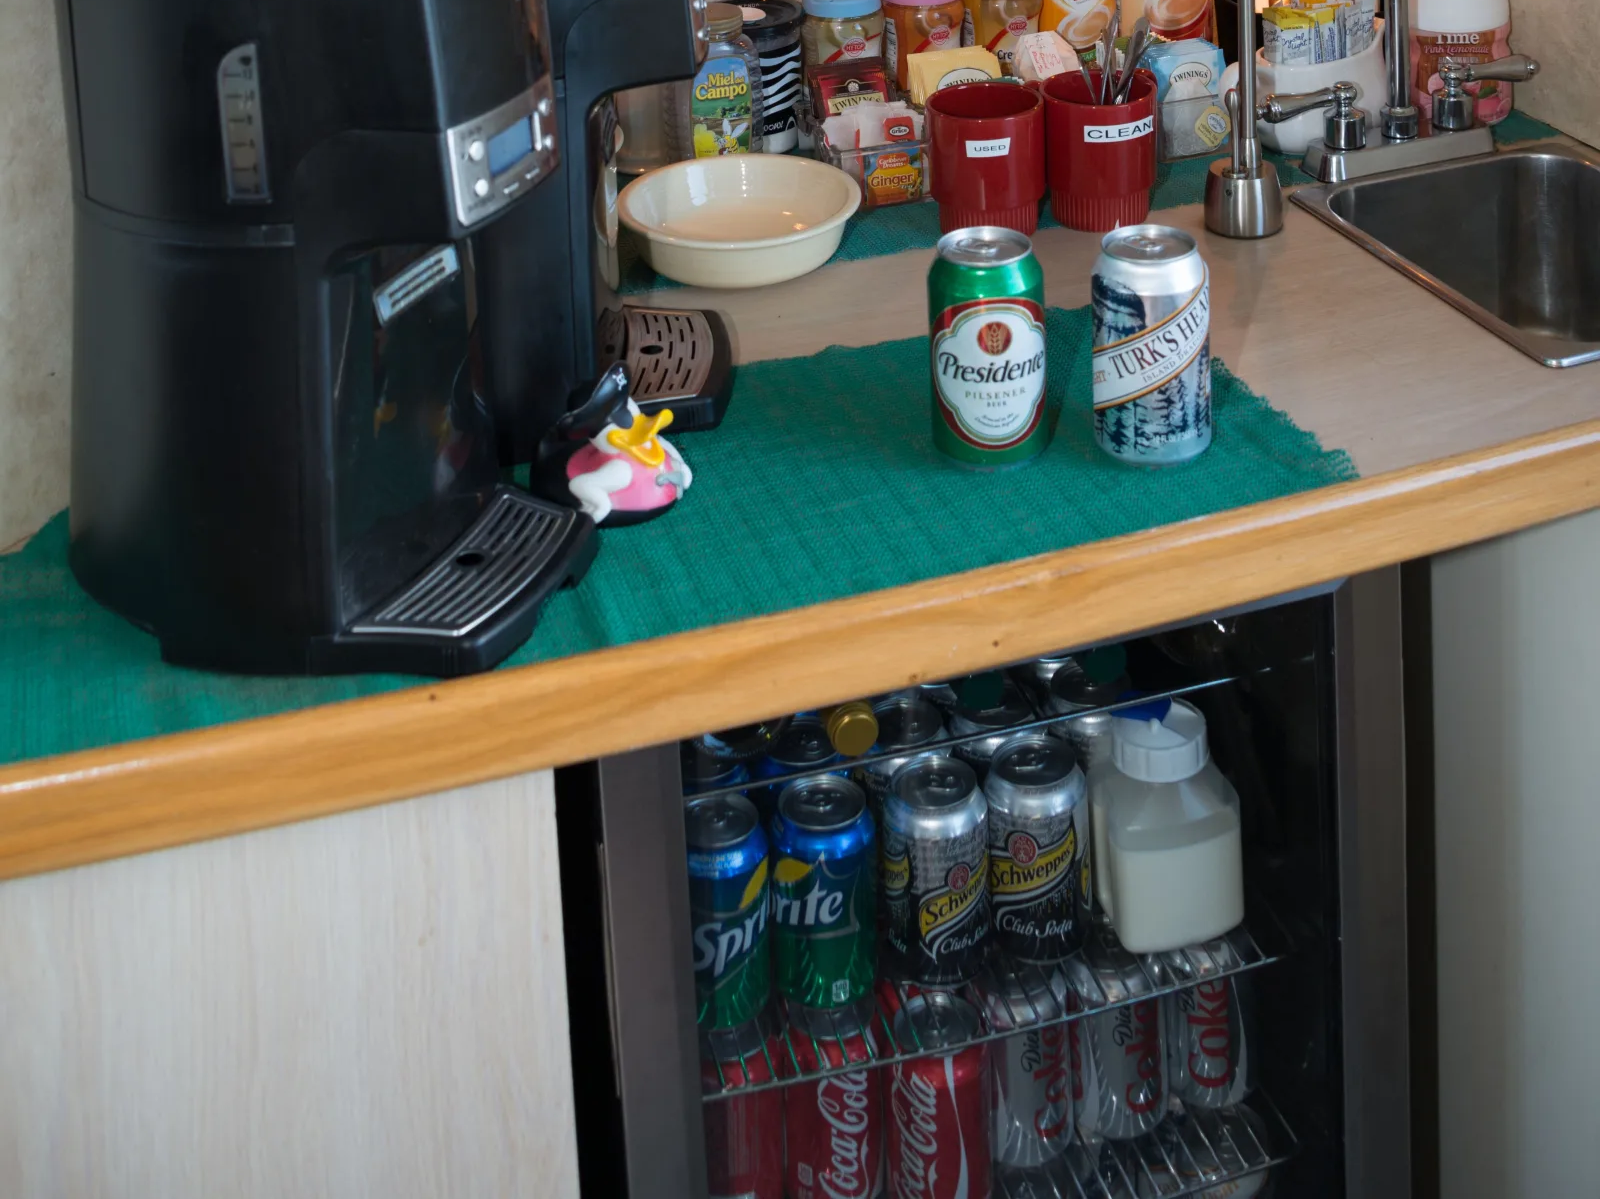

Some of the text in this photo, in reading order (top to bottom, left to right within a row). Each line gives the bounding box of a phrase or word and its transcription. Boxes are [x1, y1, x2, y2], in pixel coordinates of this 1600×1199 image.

[1282, 33, 1305, 49] Crystal
[998, 50, 1012, 60] Cre
[708, 72, 734, 87] Miel
[1173, 70, 1209, 82] TWININGS
[696, 84, 747, 100] Campo
[1087, 120, 1152, 139] CLEAN
[879, 156, 907, 165] Caribbean
[870, 173, 914, 188] Ginger
[1109, 330, 1179, 379] TURK'S
[939, 350, 1044, 383] Presidente
[1142, 361, 1176, 383] ISLAND
[964, 387, 1026, 400] PILSENER
[991, 841, 1074, 887] Schweppes
[1003, 914, 1073, 938] Club Soda
[940, 937, 969, 953] Club
[1188, 978, 1231, 1088] Coke
[1113, 998, 1162, 1114] Die Coke
[1020, 1024, 1069, 1138] Die Coke
